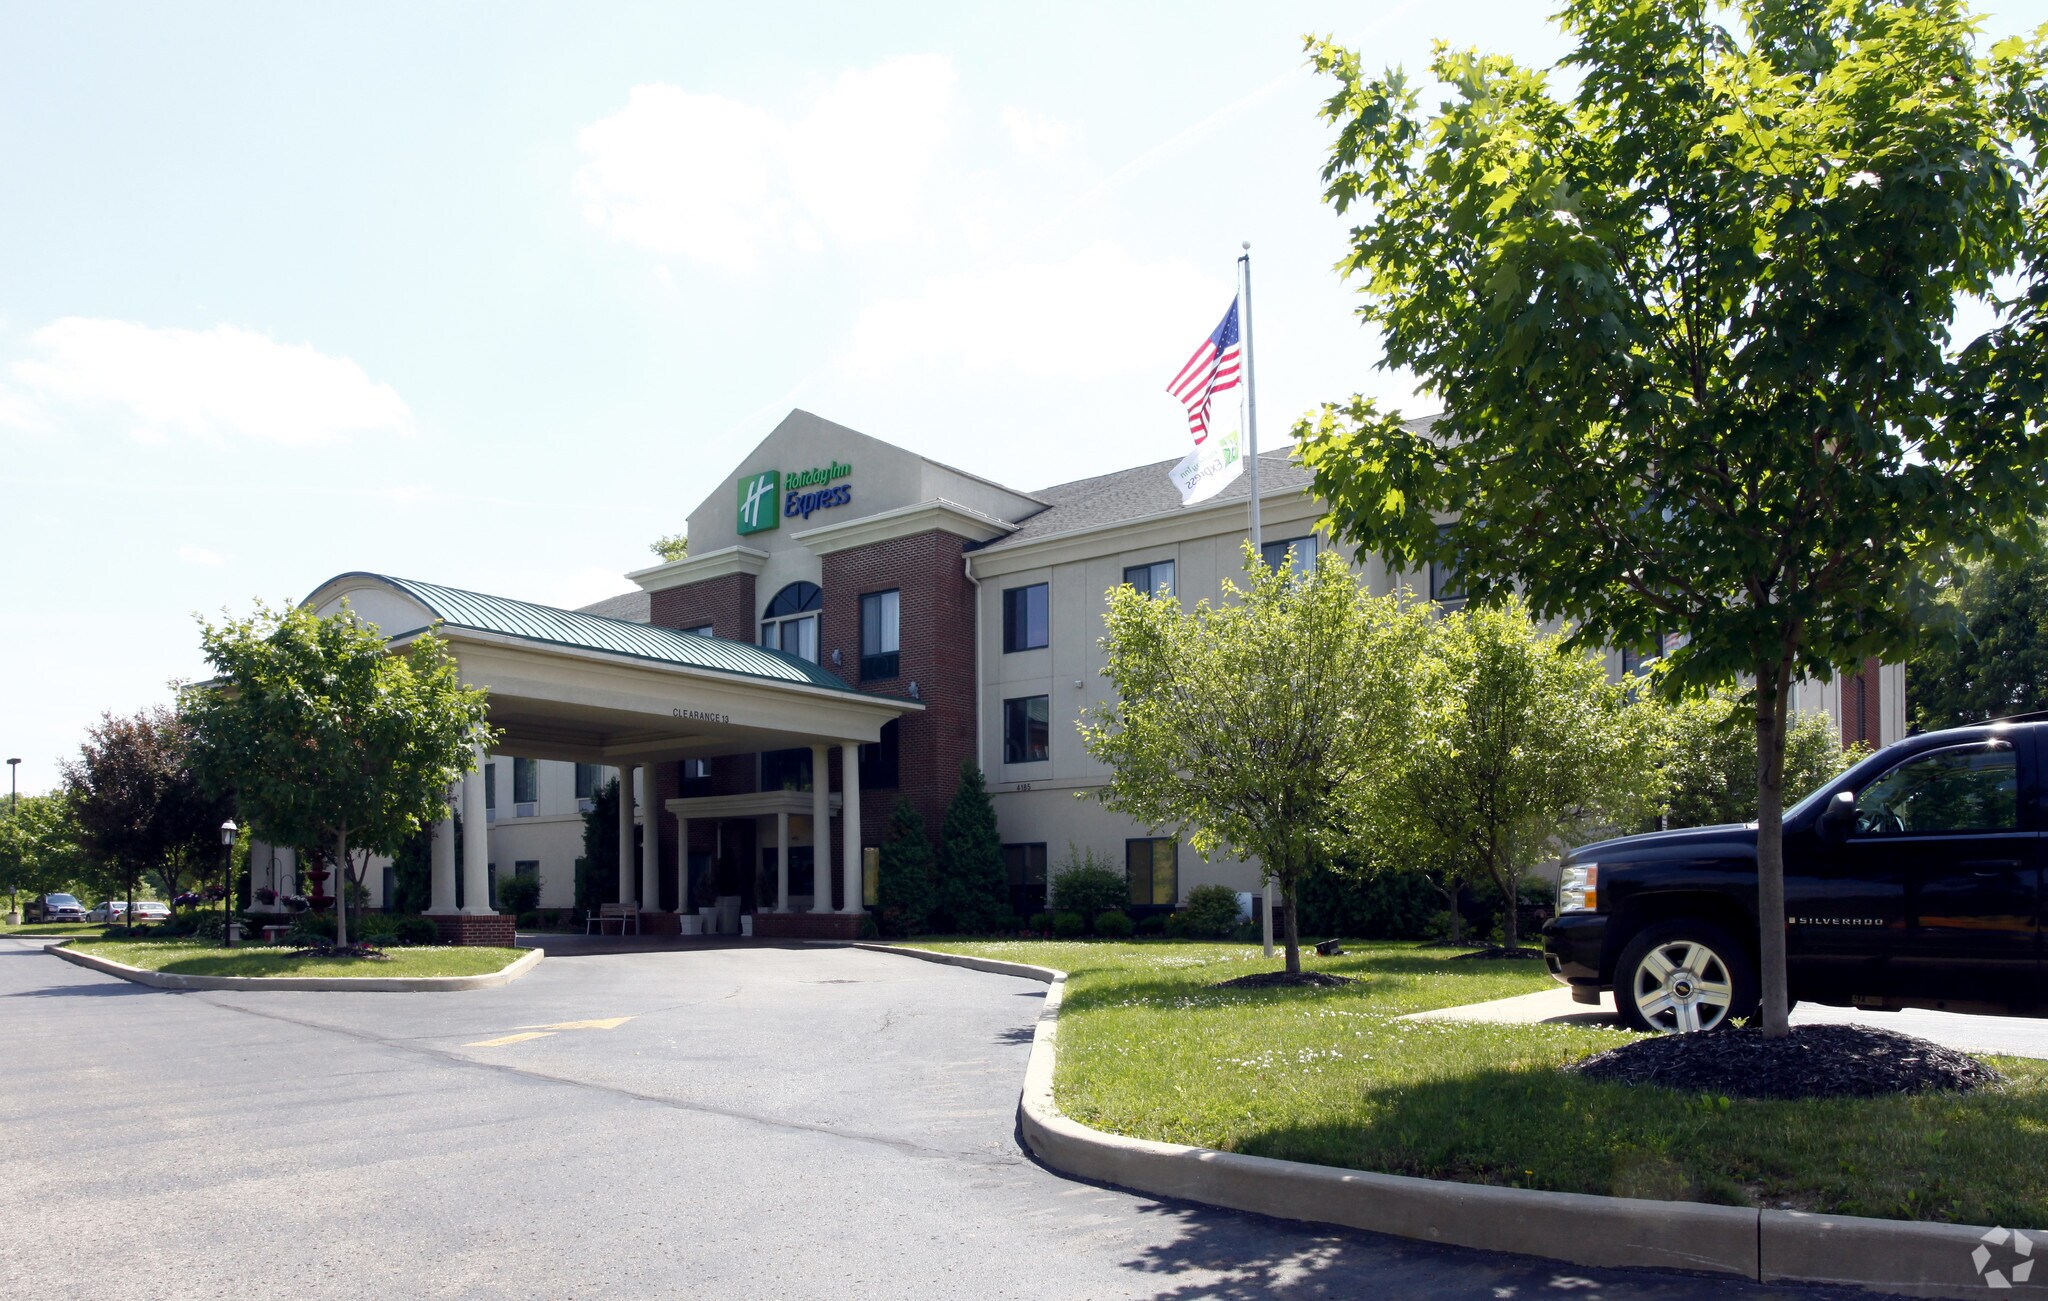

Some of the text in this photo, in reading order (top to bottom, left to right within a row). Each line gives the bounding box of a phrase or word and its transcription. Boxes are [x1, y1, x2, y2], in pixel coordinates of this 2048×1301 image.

[784, 460, 851, 491] Holiday Inn
[784, 484, 851, 520] Express
[673, 708, 729, 724] CLEARANCE 13
[1799, 918, 1883, 926] SILVERADO
